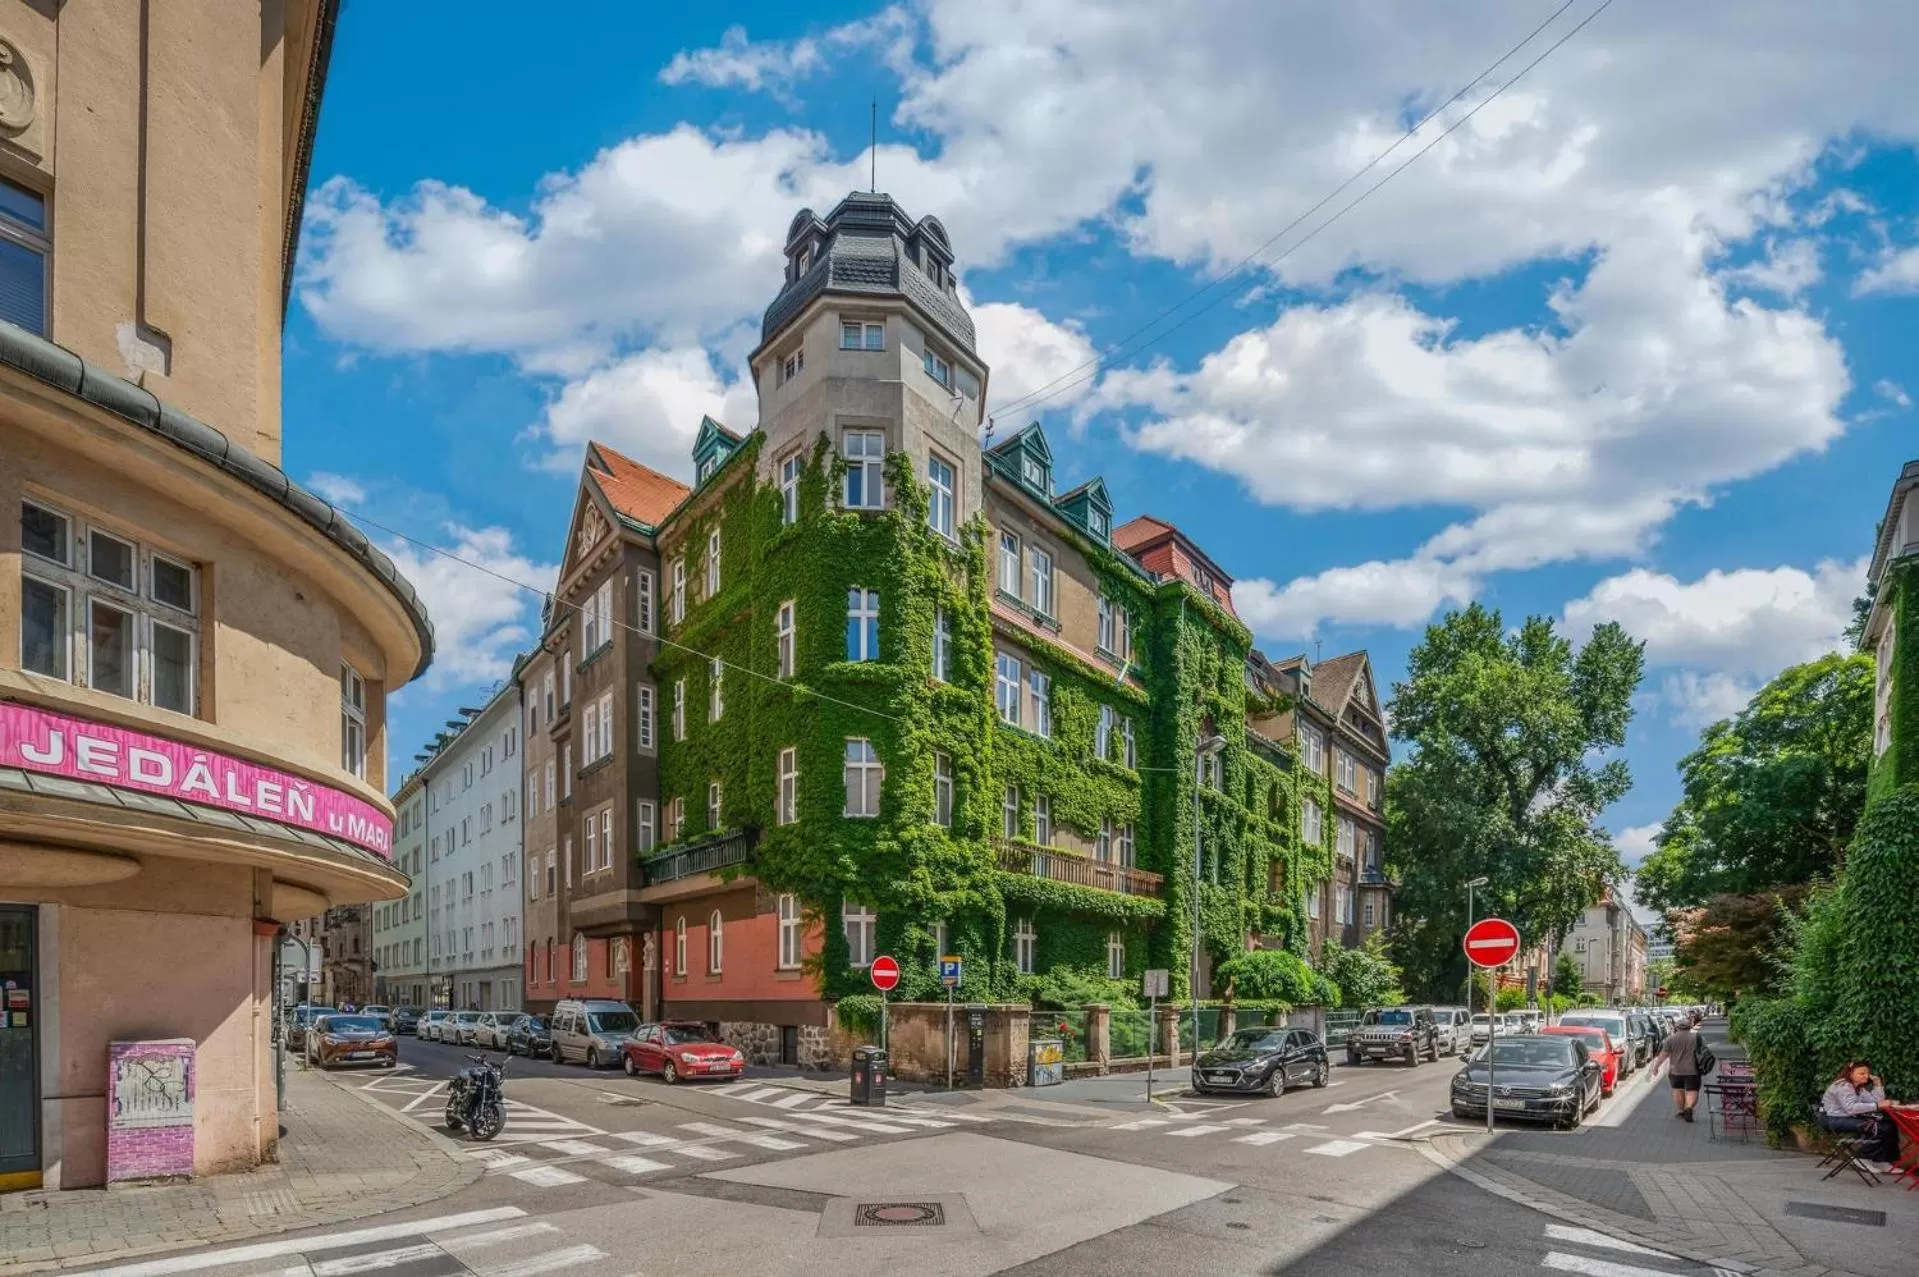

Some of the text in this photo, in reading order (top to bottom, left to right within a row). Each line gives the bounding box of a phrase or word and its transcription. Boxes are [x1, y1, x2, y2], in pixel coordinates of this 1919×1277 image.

[20, 730, 315, 822] JEDÁLEŇ
[329, 813, 343, 832] u
[944, 962, 955, 975] P
